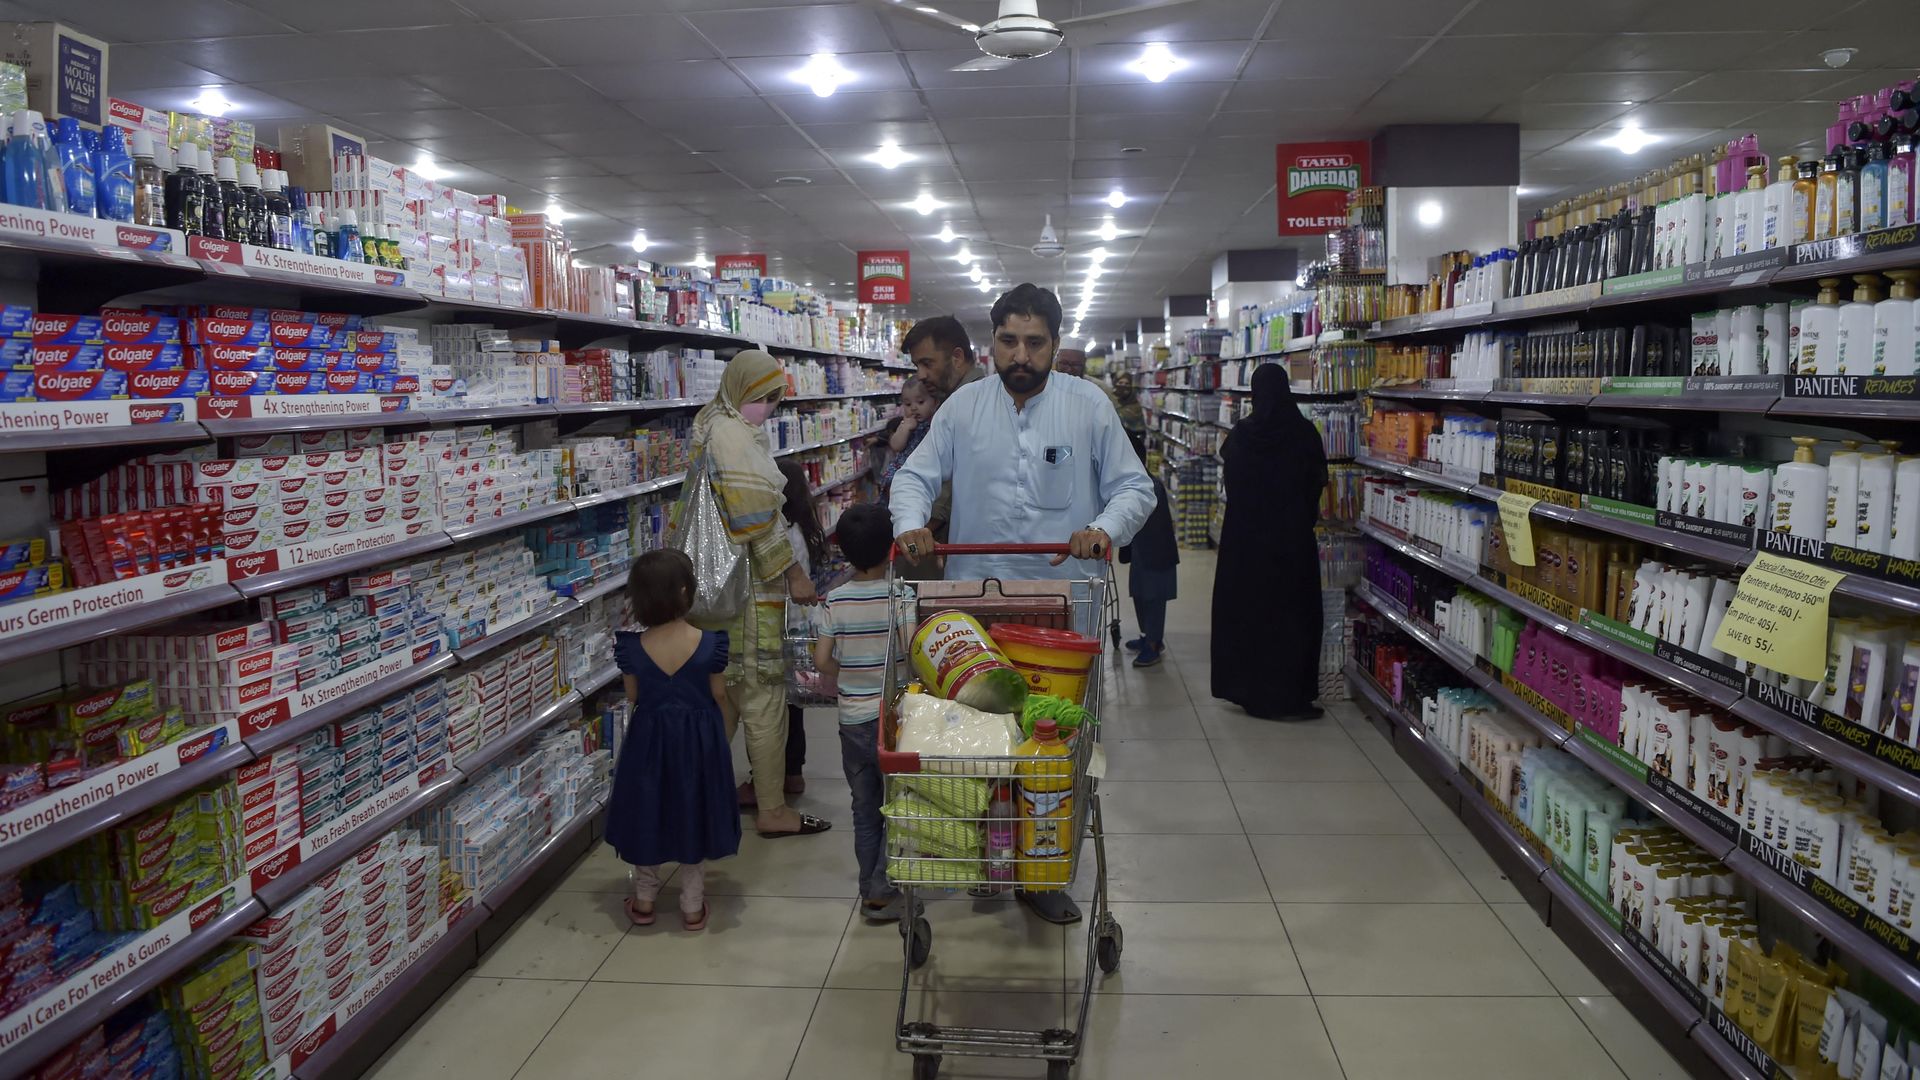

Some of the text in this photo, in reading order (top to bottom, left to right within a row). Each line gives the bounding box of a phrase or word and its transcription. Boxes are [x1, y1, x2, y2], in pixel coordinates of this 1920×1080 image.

[65, 65, 96, 84] MOUTH
[65, 76, 96, 98] WASH
[111, 102, 142, 118] Colgate
[1299, 158, 1349, 168] TAPAL
[1289, 169, 1358, 193] DANEDAR
[0, 214, 96, 240] ening Power
[1287, 216, 1346, 228] TOILETRI
[118, 231, 152, 244] Colgate
[1865, 226, 1918, 249] REDUCES
[199, 239, 229, 254] Colgate
[255, 249, 365, 281] 4x Strengthening Power
[863, 264, 905, 280] DANEDAR
[375, 273, 394, 283] Colgate
[872, 293, 896, 301] CARE
[215, 308, 248, 320] Colgate
[271, 311, 300, 323] Colgate
[319, 314, 346, 326] Colgate
[32, 319, 68, 335] lgate
[105, 317, 150, 335] Colgate
[207, 321, 246, 336] Colgate
[274, 325, 308, 339] Colgate
[356, 334, 382, 345] Colgate
[33, 349, 69, 365] lgate
[108, 347, 153, 364] Colgate
[213, 346, 251, 361] Colgate
[275, 349, 306, 362] Colgate
[356, 355, 382, 366] Colgate
[38, 374, 92, 392] Colgate
[133, 373, 180, 390] Colgate
[215, 373, 252, 388] Colgate
[276, 373, 307, 386] Colgate
[328, 372, 356, 385] Colgate
[1795, 377, 1916, 396] PANTENE REDUCES
[1570, 380, 1593, 395] SHINE
[208, 398, 239, 409] Colgate
[263, 398, 370, 416] 4x Strengthening Power
[381, 400, 399, 409] Colgate
[63, 409, 109, 425] Power
[131, 409, 165, 421] Colgate
[200, 463, 230, 473] Colgate
[263, 458, 285, 468] Colgate
[306, 455, 326, 465] Colgate
[231, 486, 255, 497] Colgate
[281, 480, 303, 490] Colgate
[1527, 486, 1550, 503] HOURS
[1551, 492, 1574, 508] SHINE
[283, 502, 305, 512] Colgate
[224, 510, 252, 522] Colgate
[284, 524, 305, 535] Colgate
[1675, 520, 1685, 530] 100%
[225, 534, 253, 546] Colgate
[290, 532, 396, 564] 12 Hours Germ Protection
[1765, 531, 1826, 559] PANTENE
[1831, 546, 1881, 569] REDUCES
[235, 556, 266, 569] Colgate
[163, 574, 188, 586] Colgate
[370, 573, 392, 585] Colgate
[1757, 560, 1830, 587] Special Ramadan Offer
[1744, 574, 1769, 590] Pantene
[1770, 583, 1801, 601] shampoo
[28, 605, 69, 625] Germ
[73, 587, 144, 615] Protection
[1518, 585, 1574, 619] 24 HOURS SHINE
[1737, 590, 1758, 605] Market
[1759, 598, 1777, 613] price:
[1778, 605, 1792, 618] 460
[1738, 611, 1756, 625] price:
[1758, 618, 1778, 633] 405/-
[218, 631, 246, 646] Colgate
[929, 628, 975, 658] Shama
[1727, 628, 1774, 653] SAVE RS 55/-
[413, 647, 431, 660] Colgate
[1672, 653, 1683, 665] 100%
[240, 655, 271, 671] Colgate
[240, 682, 271, 698] Colgate
[300, 659, 402, 709] 4x Strengthening Power
[1028, 683, 1048, 693] hama
[76, 695, 114, 715] Colgate
[1514, 681, 1568, 728] 24 HOURS SHINE
[249, 707, 277, 725] Colgate
[1758, 683, 1817, 725] PANTENE
[1821, 713, 1872, 747] REDUCES
[139, 722, 162, 741] Colgate
[179, 740, 210, 760] Colgate
[239, 761, 270, 779] Colgate
[0, 761, 160, 842] Strengthening Power
[246, 787, 273, 805] Colgate
[246, 812, 274, 831] Colgate
[311, 784, 410, 851] Xtra Fresh Breath For Hours
[1504, 812, 1526, 839] HOURS
[247, 835, 276, 856] Colgate
[260, 853, 289, 876] Colgate
[152, 889, 186, 914] Colgate
[1750, 836, 1910, 952] PANTENE REDUCES HAIRFALL
[264, 954, 292, 977] Colgate
[35, 998, 66, 1024] Care
[68, 984, 88, 1006] For
[91, 961, 125, 989] Teeth
[128, 954, 136, 968] &
[138, 934, 171, 960] Gums
[346, 931, 439, 1018] Xtra Fresh Breath For Hours
[266, 977, 294, 999] Colgate
[300, 1025, 326, 1051] Colgate
[1717, 1013, 1770, 1075] PANTENE
